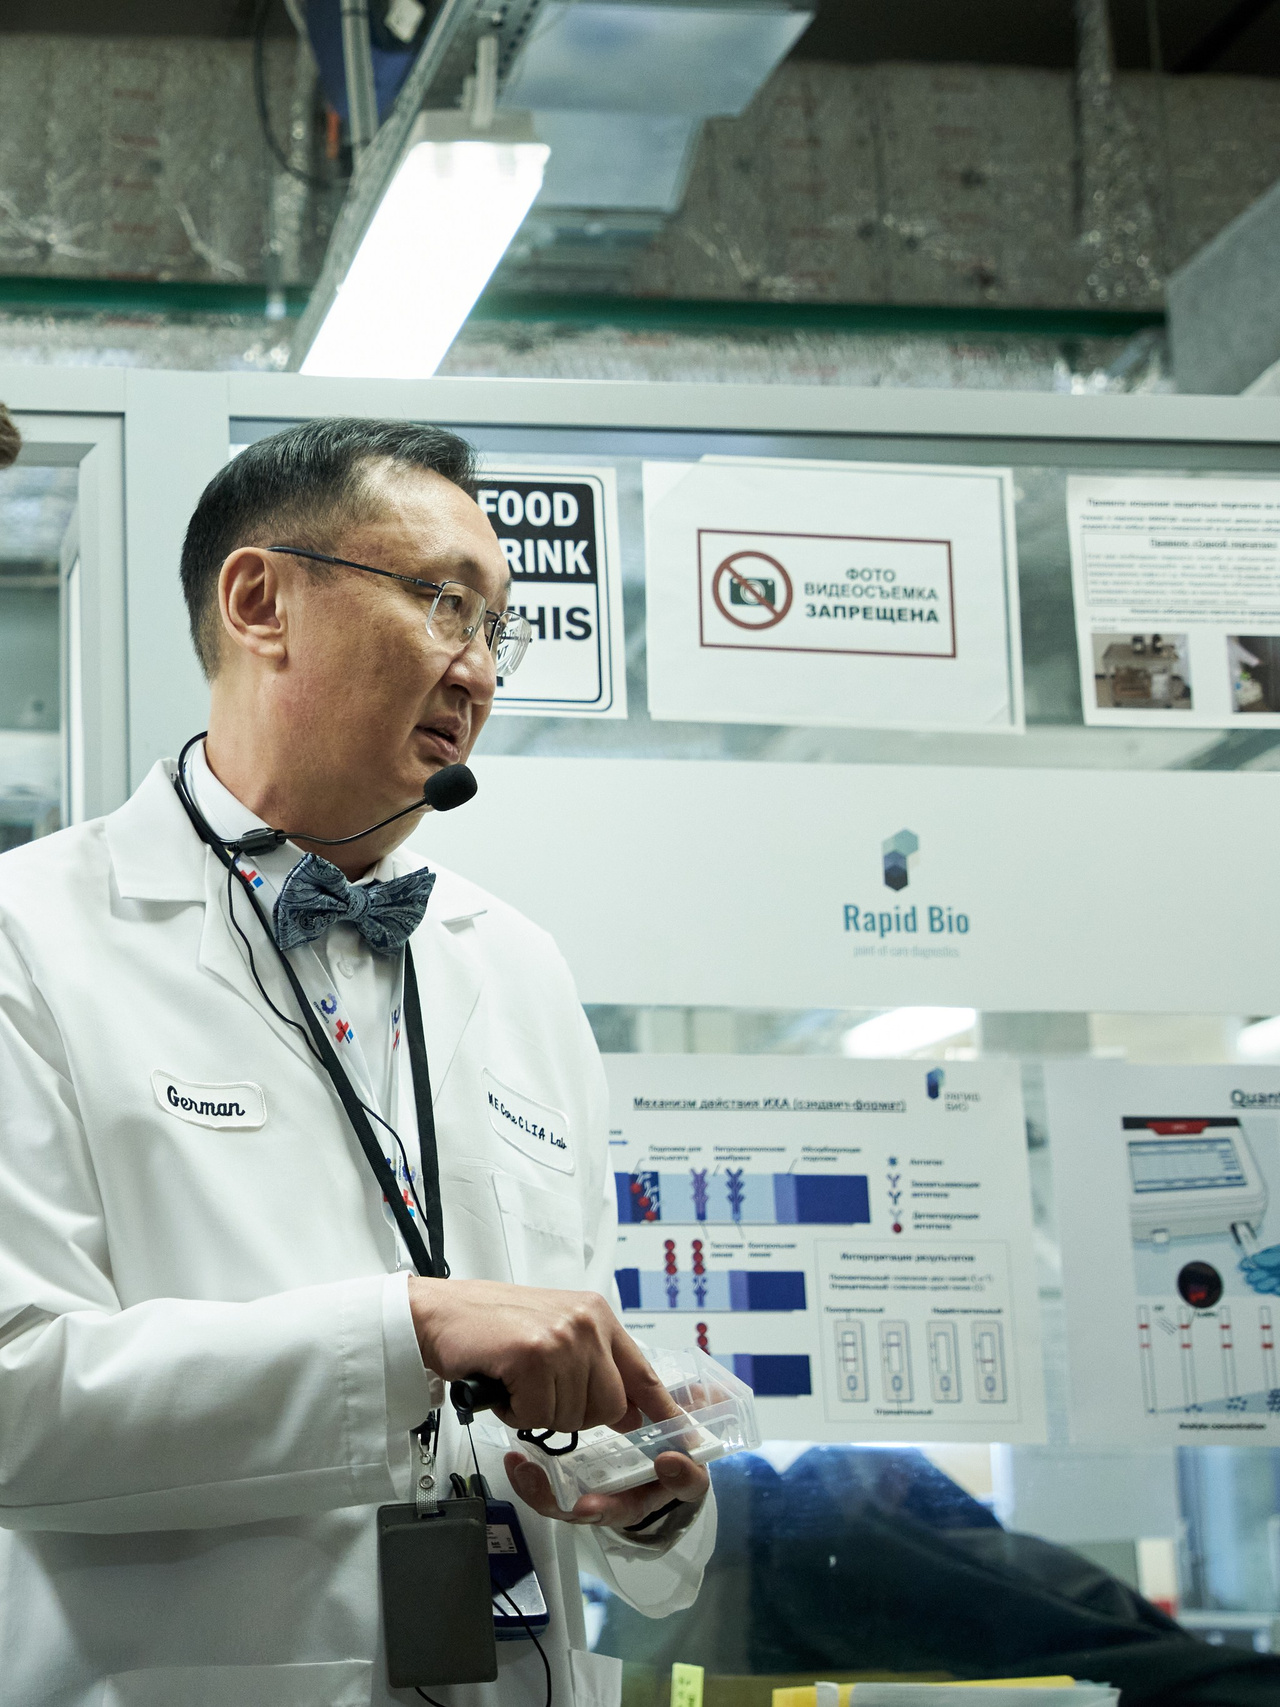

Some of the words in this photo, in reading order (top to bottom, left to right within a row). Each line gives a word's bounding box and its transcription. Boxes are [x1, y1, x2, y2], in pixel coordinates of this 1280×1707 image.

[477, 490, 579, 527] FOOD
[498, 538, 591, 575] RINK
[846, 567, 896, 583] ФОТО
[804, 582, 939, 601] ВИДЕОСЪЕМКА
[507, 606, 593, 640] HIS
[805, 604, 940, 624] ЗАПРЕЩЕНА
[843, 904, 917, 938] Rapid
[928, 906, 969, 934] Bio
[167, 1085, 245, 1116] German
[550, 1132, 567, 1150] Lab
